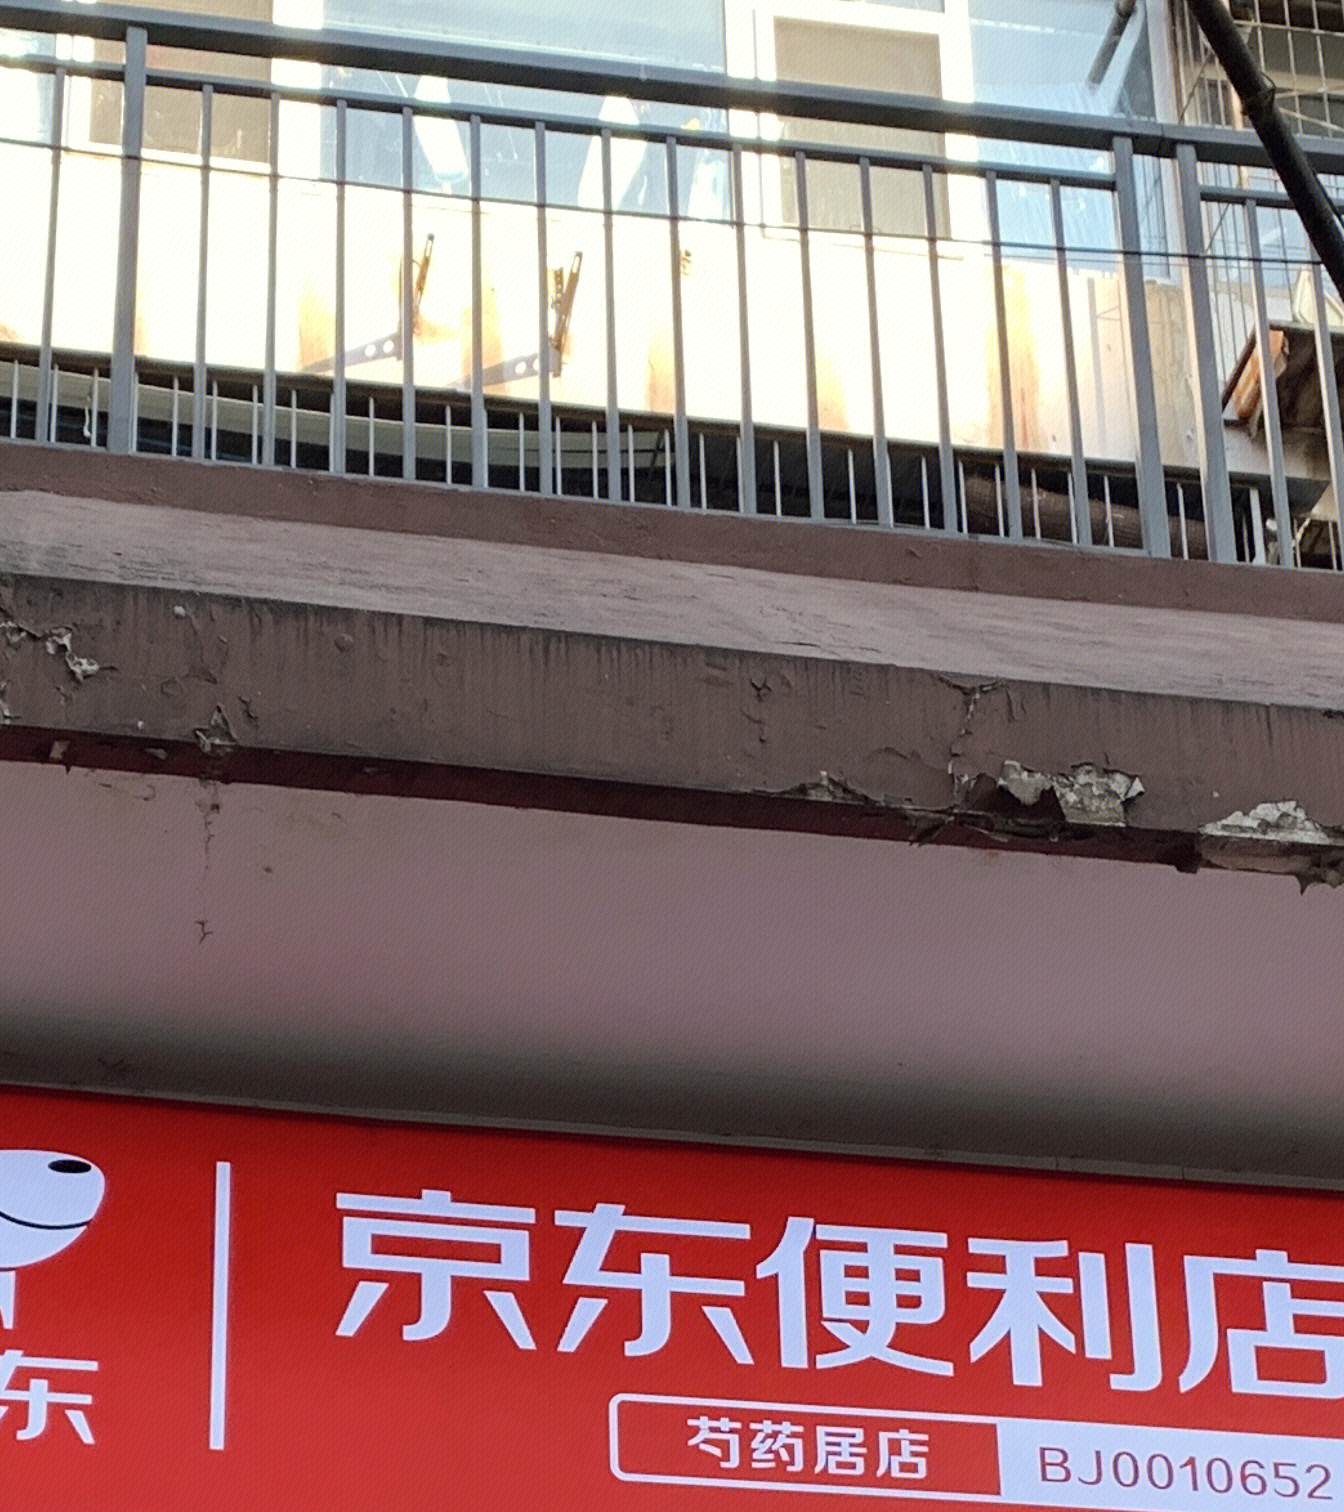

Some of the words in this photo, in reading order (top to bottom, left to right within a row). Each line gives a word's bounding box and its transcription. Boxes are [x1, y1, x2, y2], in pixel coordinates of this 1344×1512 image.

[686, 1415, 930, 1480] 芍药居店
[1038, 1446, 1335, 1501] BJ0010652
